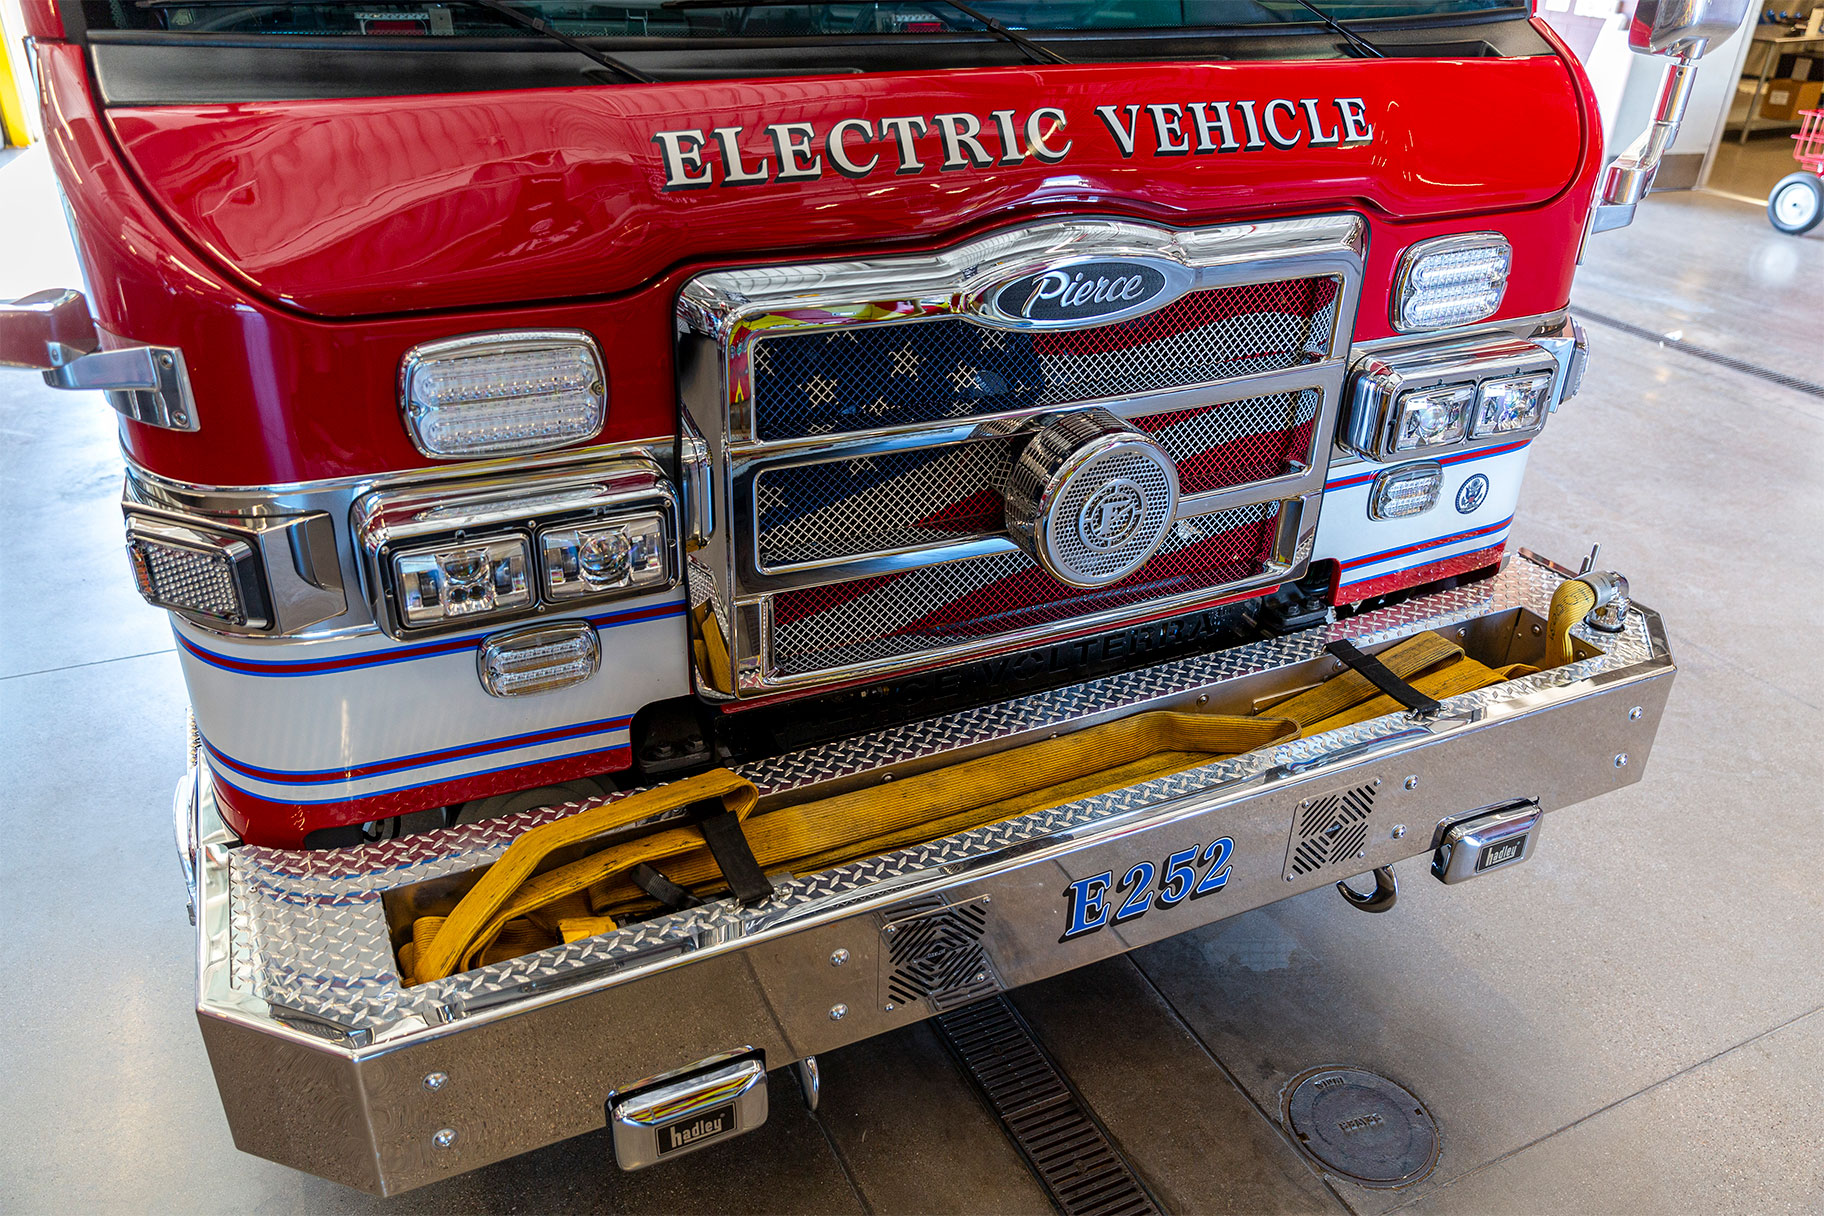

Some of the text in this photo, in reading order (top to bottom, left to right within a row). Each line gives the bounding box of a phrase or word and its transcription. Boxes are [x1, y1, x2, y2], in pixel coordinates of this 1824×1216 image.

[652, 97, 1375, 193] ELECTRIC VEHICLE
[1020, 270, 1145, 318] Pierce
[1485, 845, 1518, 867] hadley
[1057, 835, 1236, 944] E252
[670, 1117, 723, 1149] hadley
